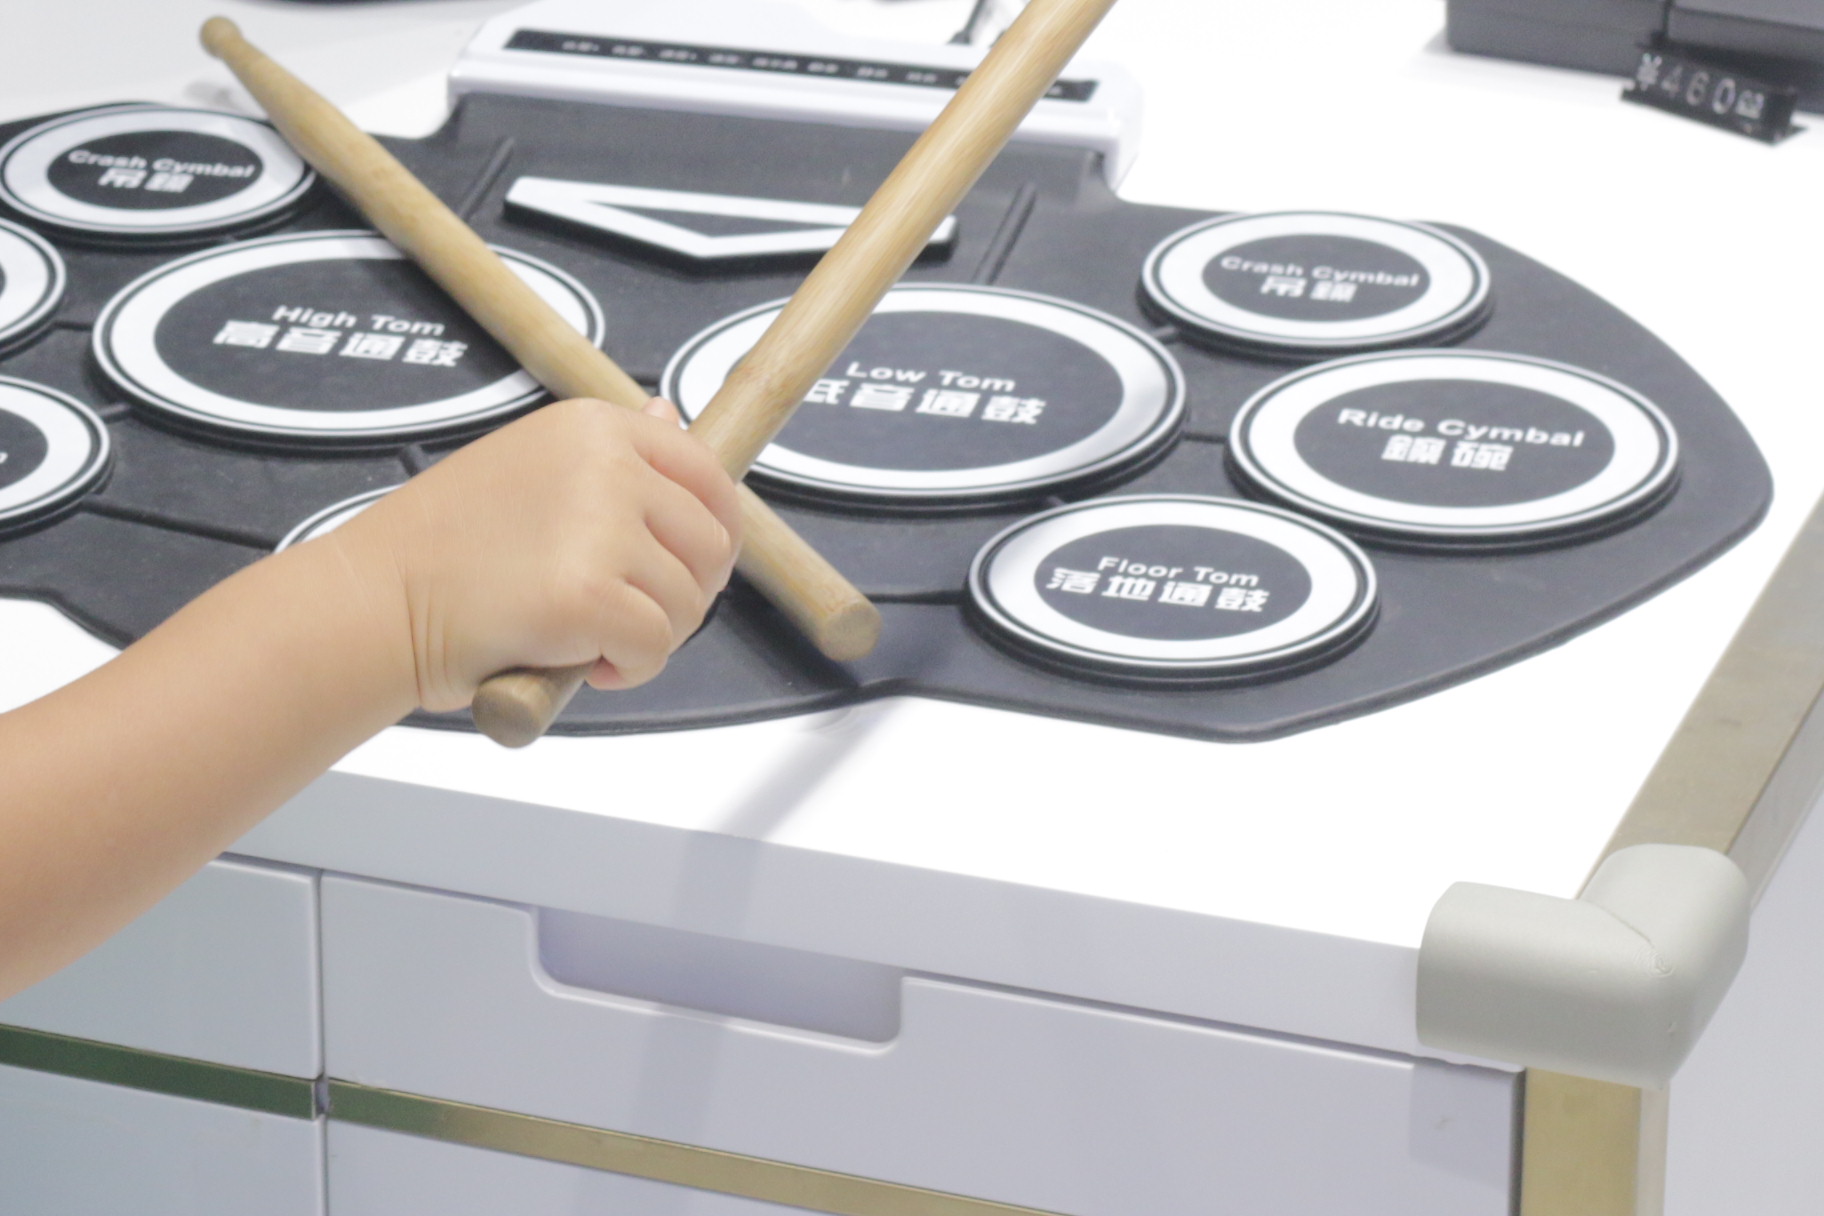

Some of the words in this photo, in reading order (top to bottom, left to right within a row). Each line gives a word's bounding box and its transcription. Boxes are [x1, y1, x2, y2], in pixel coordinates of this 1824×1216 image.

[68, 149, 148, 169] Crash
[152, 157, 255, 178] Cymbal
[1220, 255, 1304, 277] Crash
[1311, 265, 1420, 287] Cymbal
[272, 305, 357, 329] High
[371, 314, 446, 336] Tom
[213, 320, 468, 367] 高音通鼓
[845, 361, 927, 383] Low
[939, 370, 1016, 392] Tom
[1337, 408, 1425, 432] Ride
[1436, 419, 1585, 447] Cymbal
[1097, 556, 1183, 580] Floor
[1193, 566, 1259, 588] Tom
[1045, 567, 1270, 613] 落地通鼓
